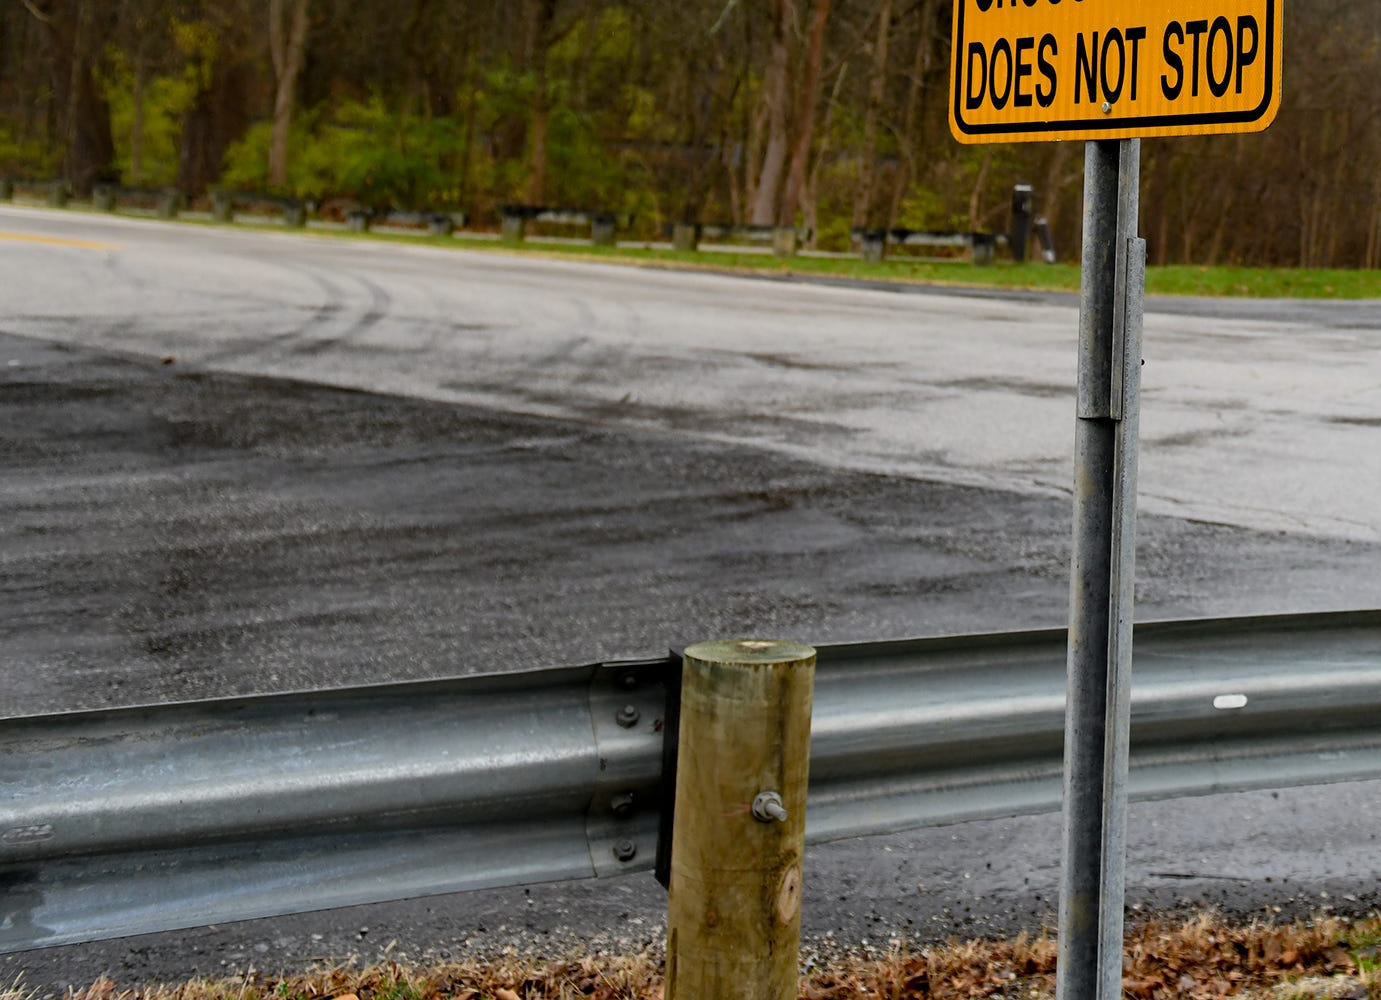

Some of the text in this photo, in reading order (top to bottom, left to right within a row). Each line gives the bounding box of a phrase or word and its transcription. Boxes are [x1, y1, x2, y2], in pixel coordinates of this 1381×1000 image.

[966, 14, 1259, 111] DOES NOT STOP
